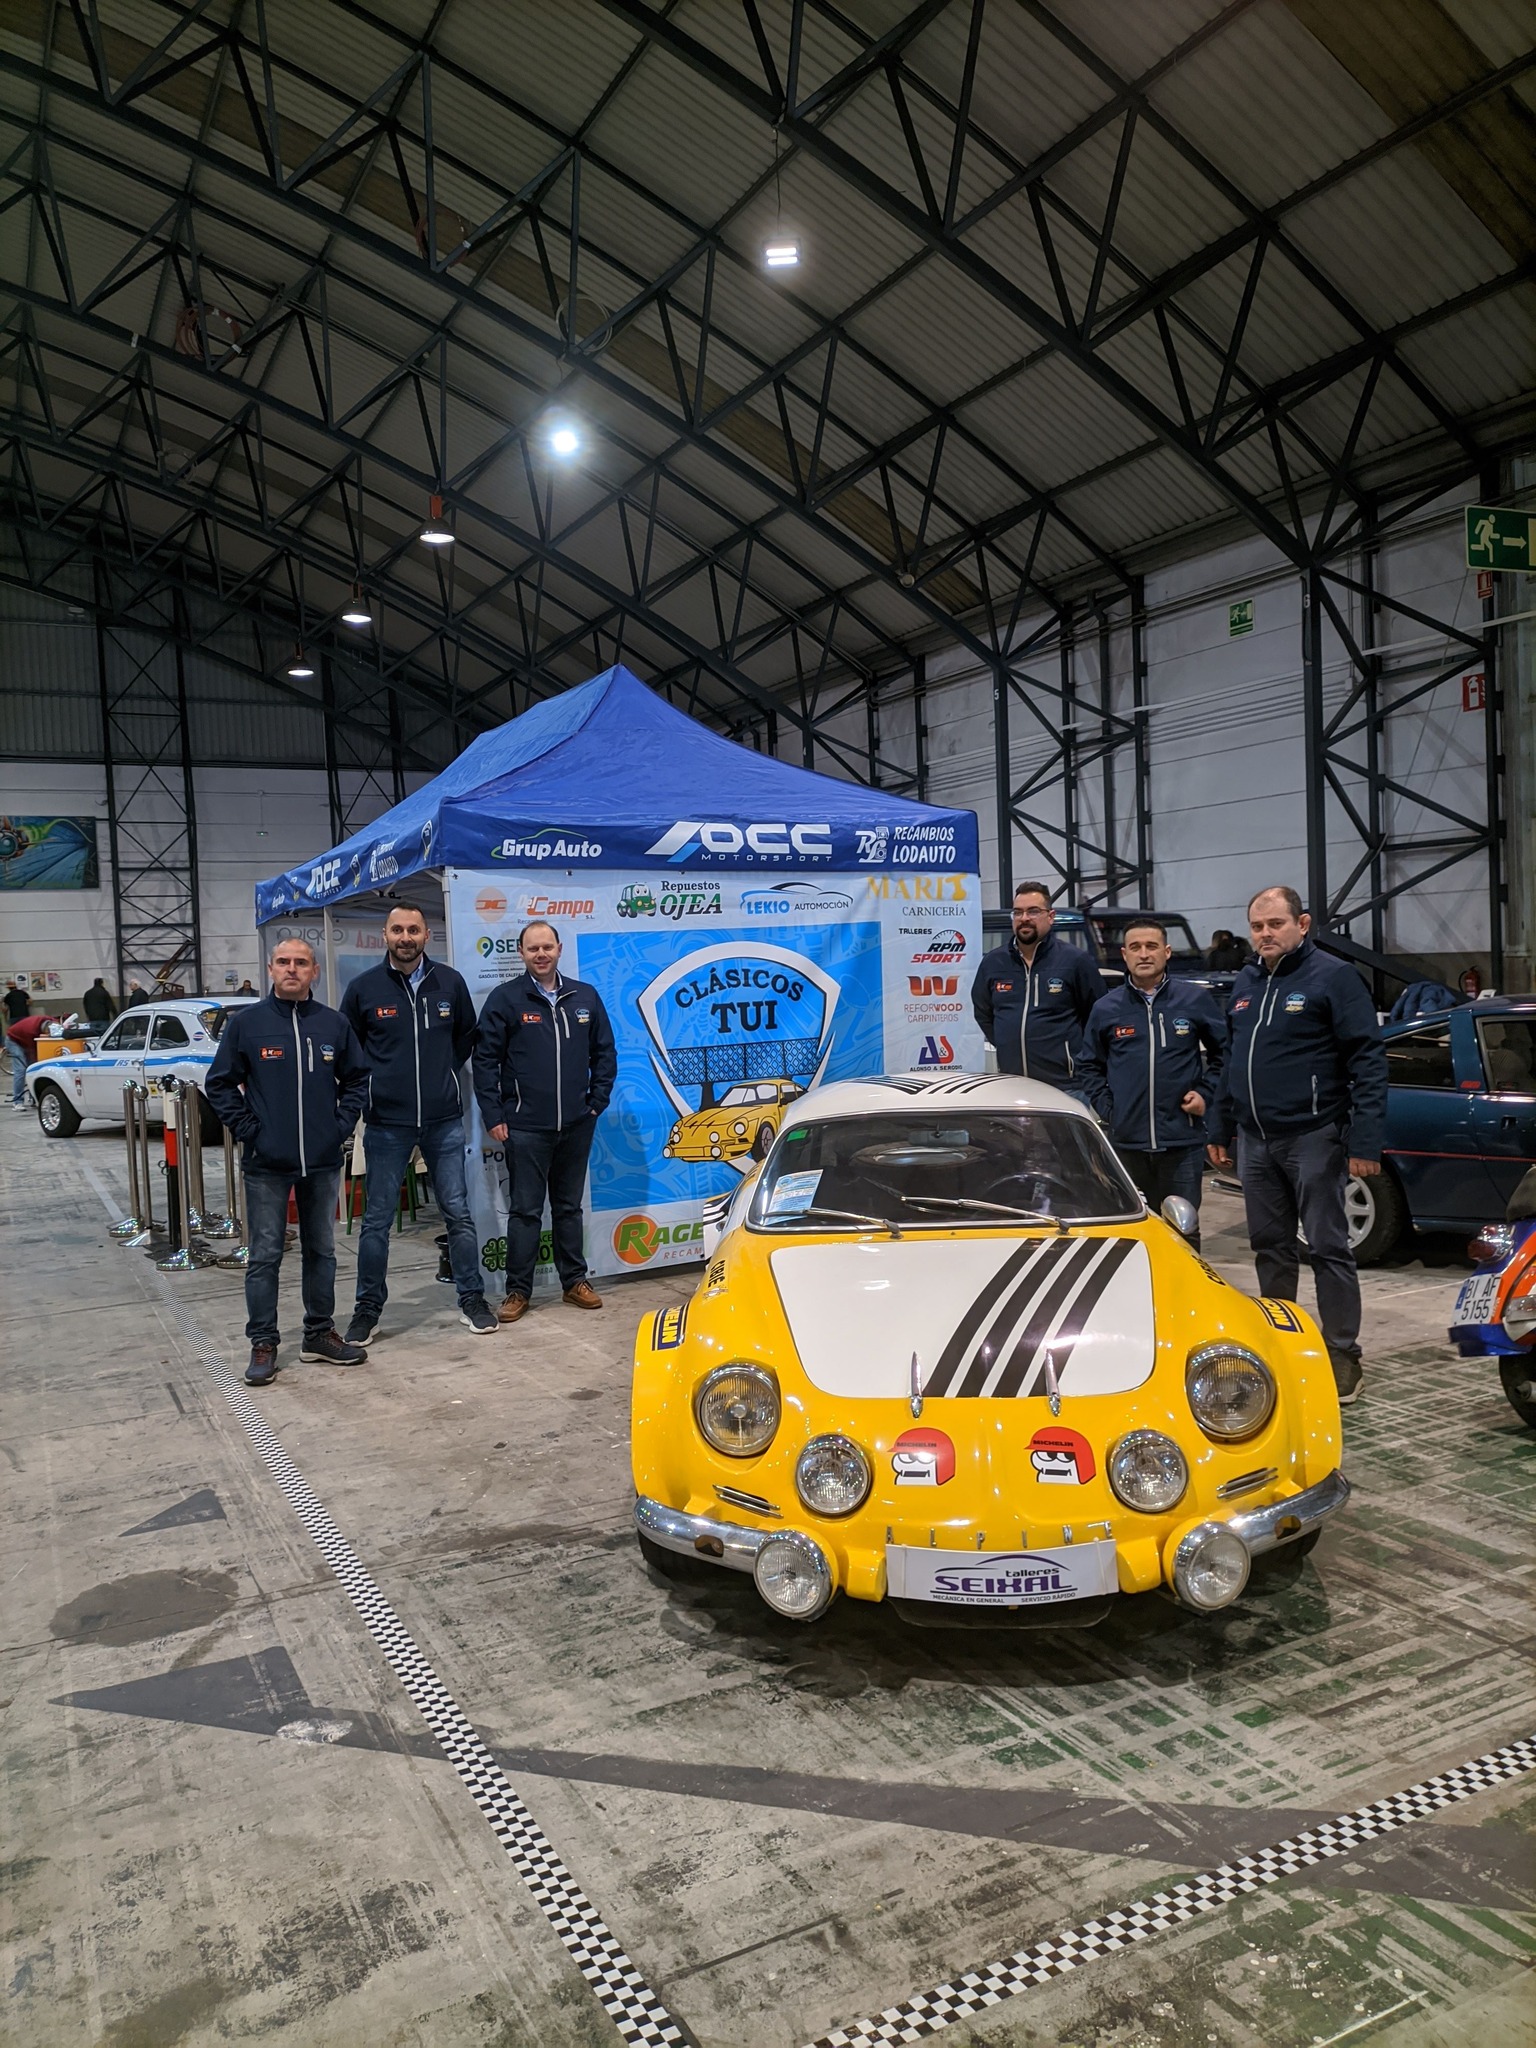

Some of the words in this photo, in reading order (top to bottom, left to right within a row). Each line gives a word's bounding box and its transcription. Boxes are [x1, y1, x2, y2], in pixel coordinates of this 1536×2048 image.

[893, 826, 955, 842] RECAMBIOS
[701, 853, 833, 862] MOTORSPORT
[893, 844, 956, 864] LODAUTO
[661, 880, 721, 893] Repuestos
[660, 892, 723, 921] OJEA
[746, 901, 790, 914] LEKIO
[794, 899, 849, 911] AUTOMOCIÓN
[902, 904, 967, 917] CARNICERÍA
[898, 927, 932, 935] TALLERES
[495, 939, 521, 953] SE
[927, 942, 966, 953] RPM
[910, 953, 967, 964] SPORT
[674, 967, 804, 1009] CLÁSICOS
[904, 1003, 963, 1013] REFORWOOD
[710, 1000, 778, 1034] TUI
[908, 1013, 959, 1023] CARPINTEROS
[116, 1059, 130, 1067] RS
[617, 1222, 704, 1259] RAGE
[664, 1247, 704, 1259] RECAM
[1465, 1279, 1480, 1300] BI
[1481, 1277, 1501, 1298] AF
[1461, 1299, 1492, 1321] 5155
[1032, 1439, 1075, 1448] MICHELIN
[1005, 1567, 1060, 1578] talleres
[932, 1594, 966, 1603] MECÁNICA
[1021, 1595, 1052, 1603] SERVICIO
[1052, 1591, 1076, 1601] RÁPIDO
